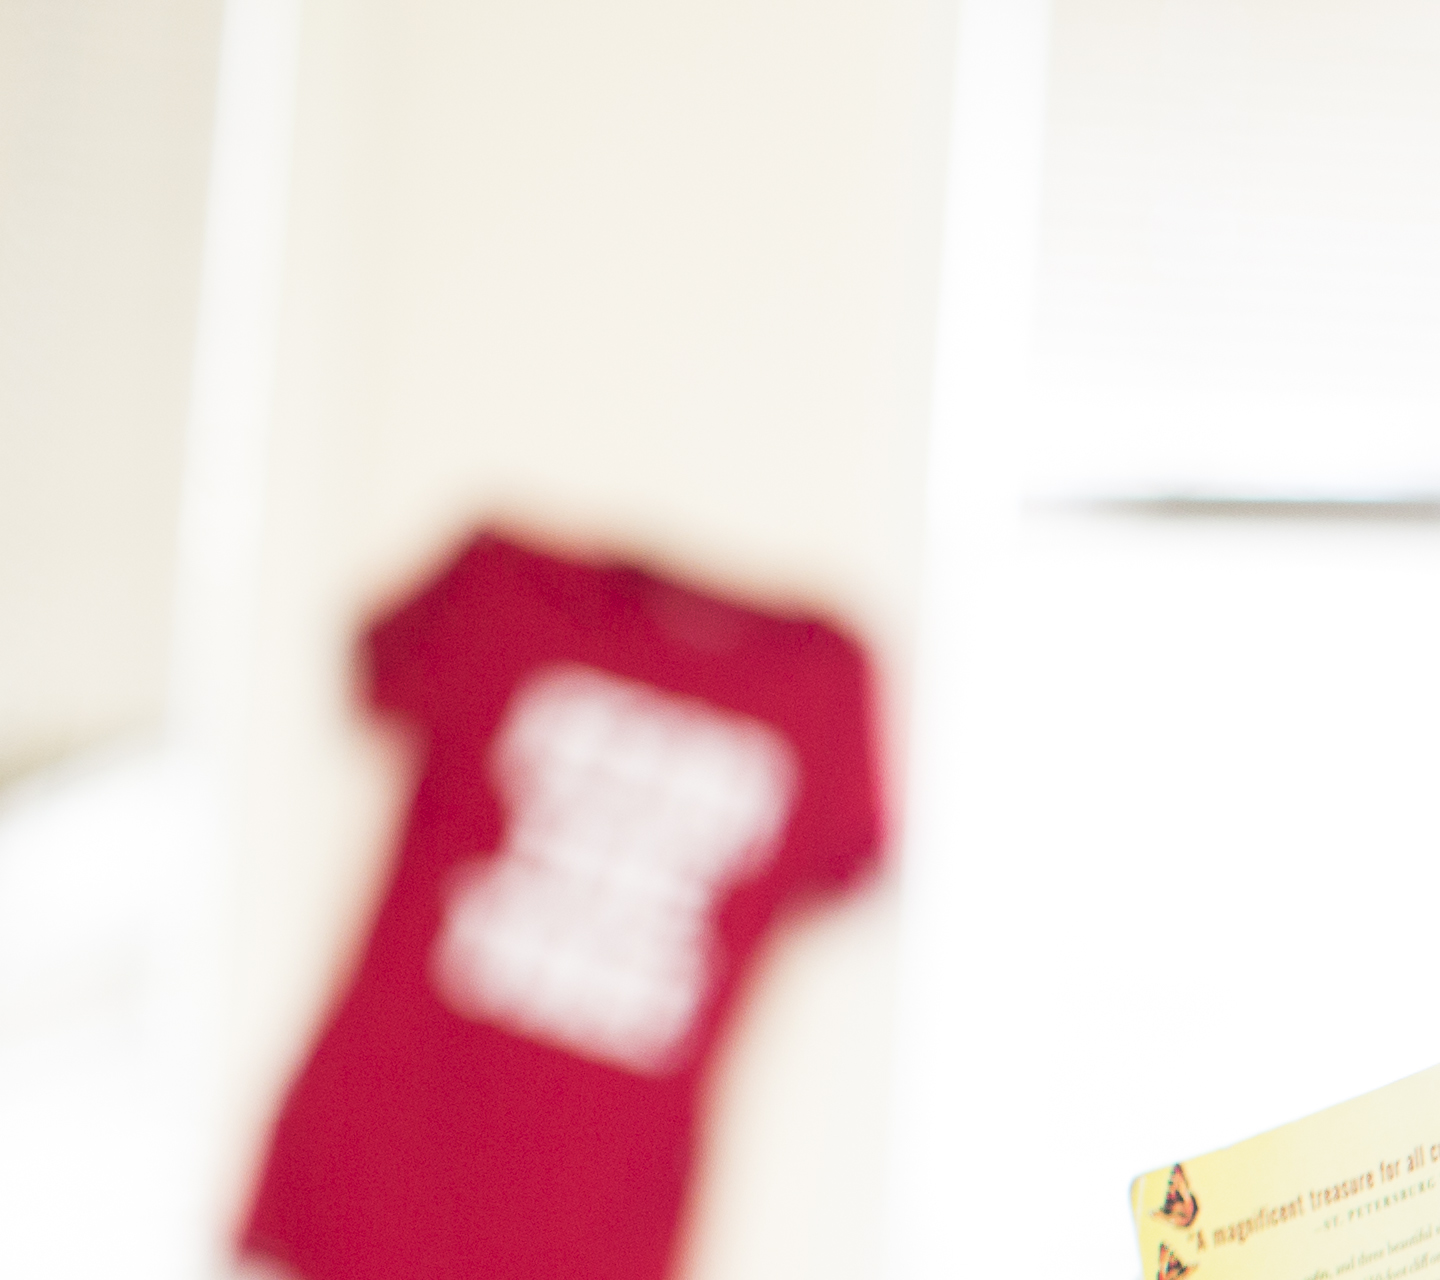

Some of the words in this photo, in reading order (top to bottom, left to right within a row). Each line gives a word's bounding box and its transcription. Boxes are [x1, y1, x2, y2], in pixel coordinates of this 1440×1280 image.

[1211, 1195, 1305, 1247] magnificent
[1310, 1171, 1374, 1211] treasure
[1378, 1160, 1402, 1183] for
[1406, 1146, 1425, 1173] all
[1347, 1178, 1435, 1222] PETERSBURG
